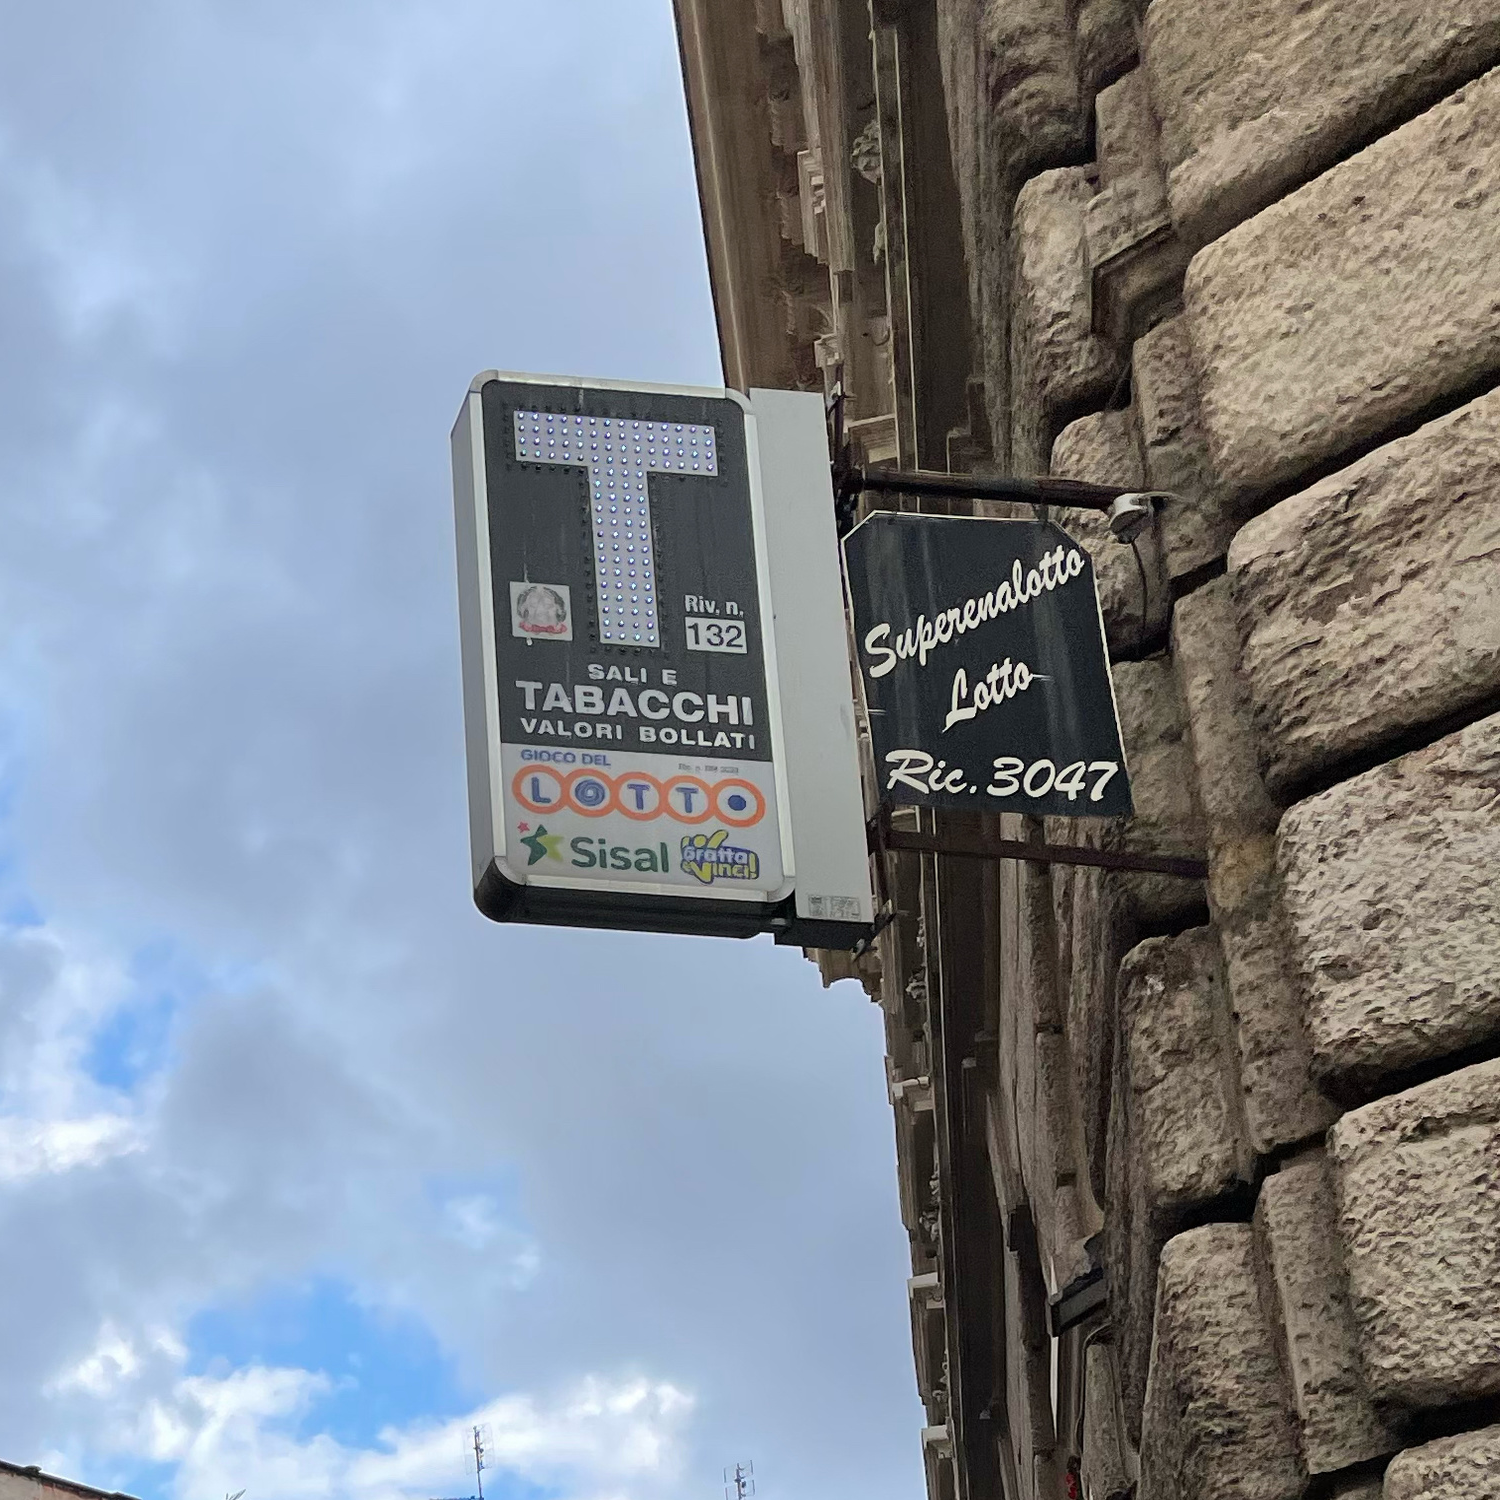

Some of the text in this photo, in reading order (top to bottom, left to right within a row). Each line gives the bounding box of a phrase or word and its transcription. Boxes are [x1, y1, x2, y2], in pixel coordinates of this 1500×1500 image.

[514, 410, 718, 648] T
[864, 544, 1086, 679] Superenalotto
[687, 623, 744, 648] 132
[587, 663, 678, 686] SALI E
[942, 657, 1035, 734] Lotto
[515, 680, 755, 726] TABACCHI
[520, 717, 756, 750] VALORI BOLLATI
[520, 749, 612, 767] GIOCO DEL
[885, 749, 1119, 802] Ric. 3047
[531, 774, 766, 828] LOTTO
[570, 836, 670, 874] Sisal
[683, 846, 748, 864] Gratta
